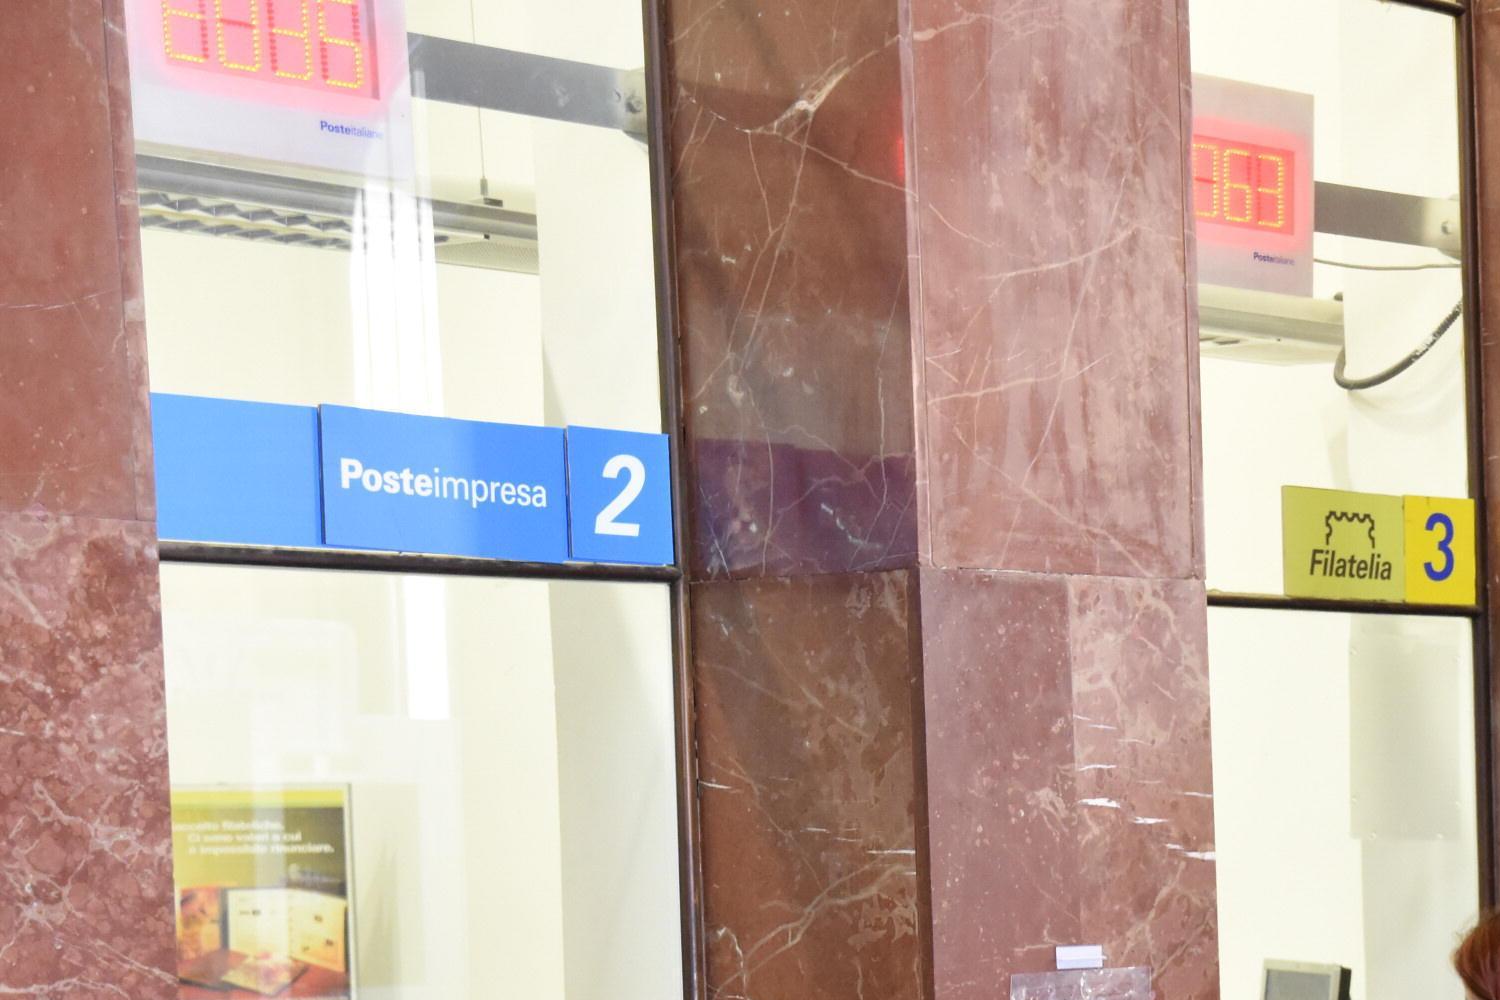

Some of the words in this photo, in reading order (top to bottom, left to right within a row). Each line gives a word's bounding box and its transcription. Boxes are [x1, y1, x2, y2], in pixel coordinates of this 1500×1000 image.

[339, 456, 548, 509] Posteimpresa
[594, 453, 647, 537] 2
[1309, 549, 1393, 581] Filatelia
[1423, 512, 1455, 582] 3
